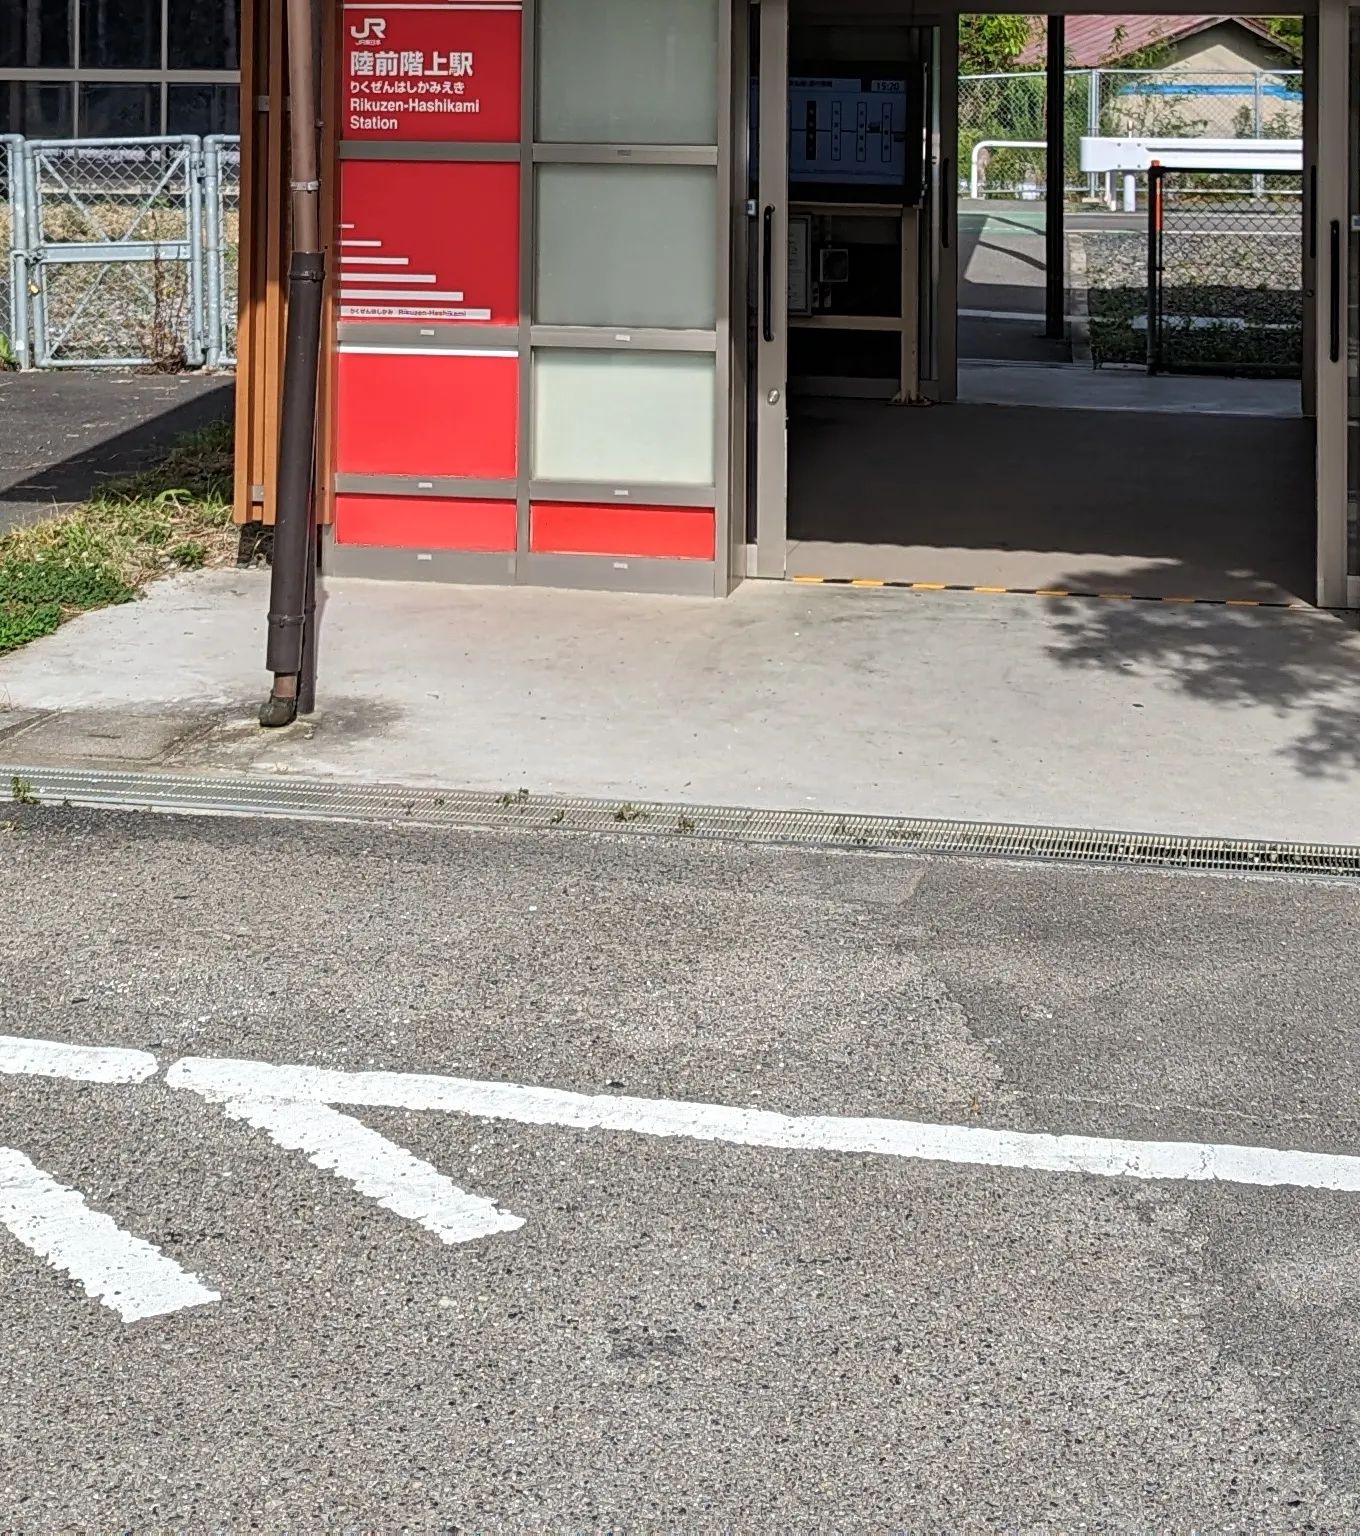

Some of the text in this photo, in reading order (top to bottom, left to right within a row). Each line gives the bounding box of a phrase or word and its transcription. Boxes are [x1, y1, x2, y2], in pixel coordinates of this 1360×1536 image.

[350, 18, 386, 38] JR
[350, 50, 473, 77] 陸前階上駅
[350, 80, 465, 94] りくぜんはしかみえき
[350, 97, 480, 113] Rikuzen-Hashikami
[350, 115, 398, 130] Station
